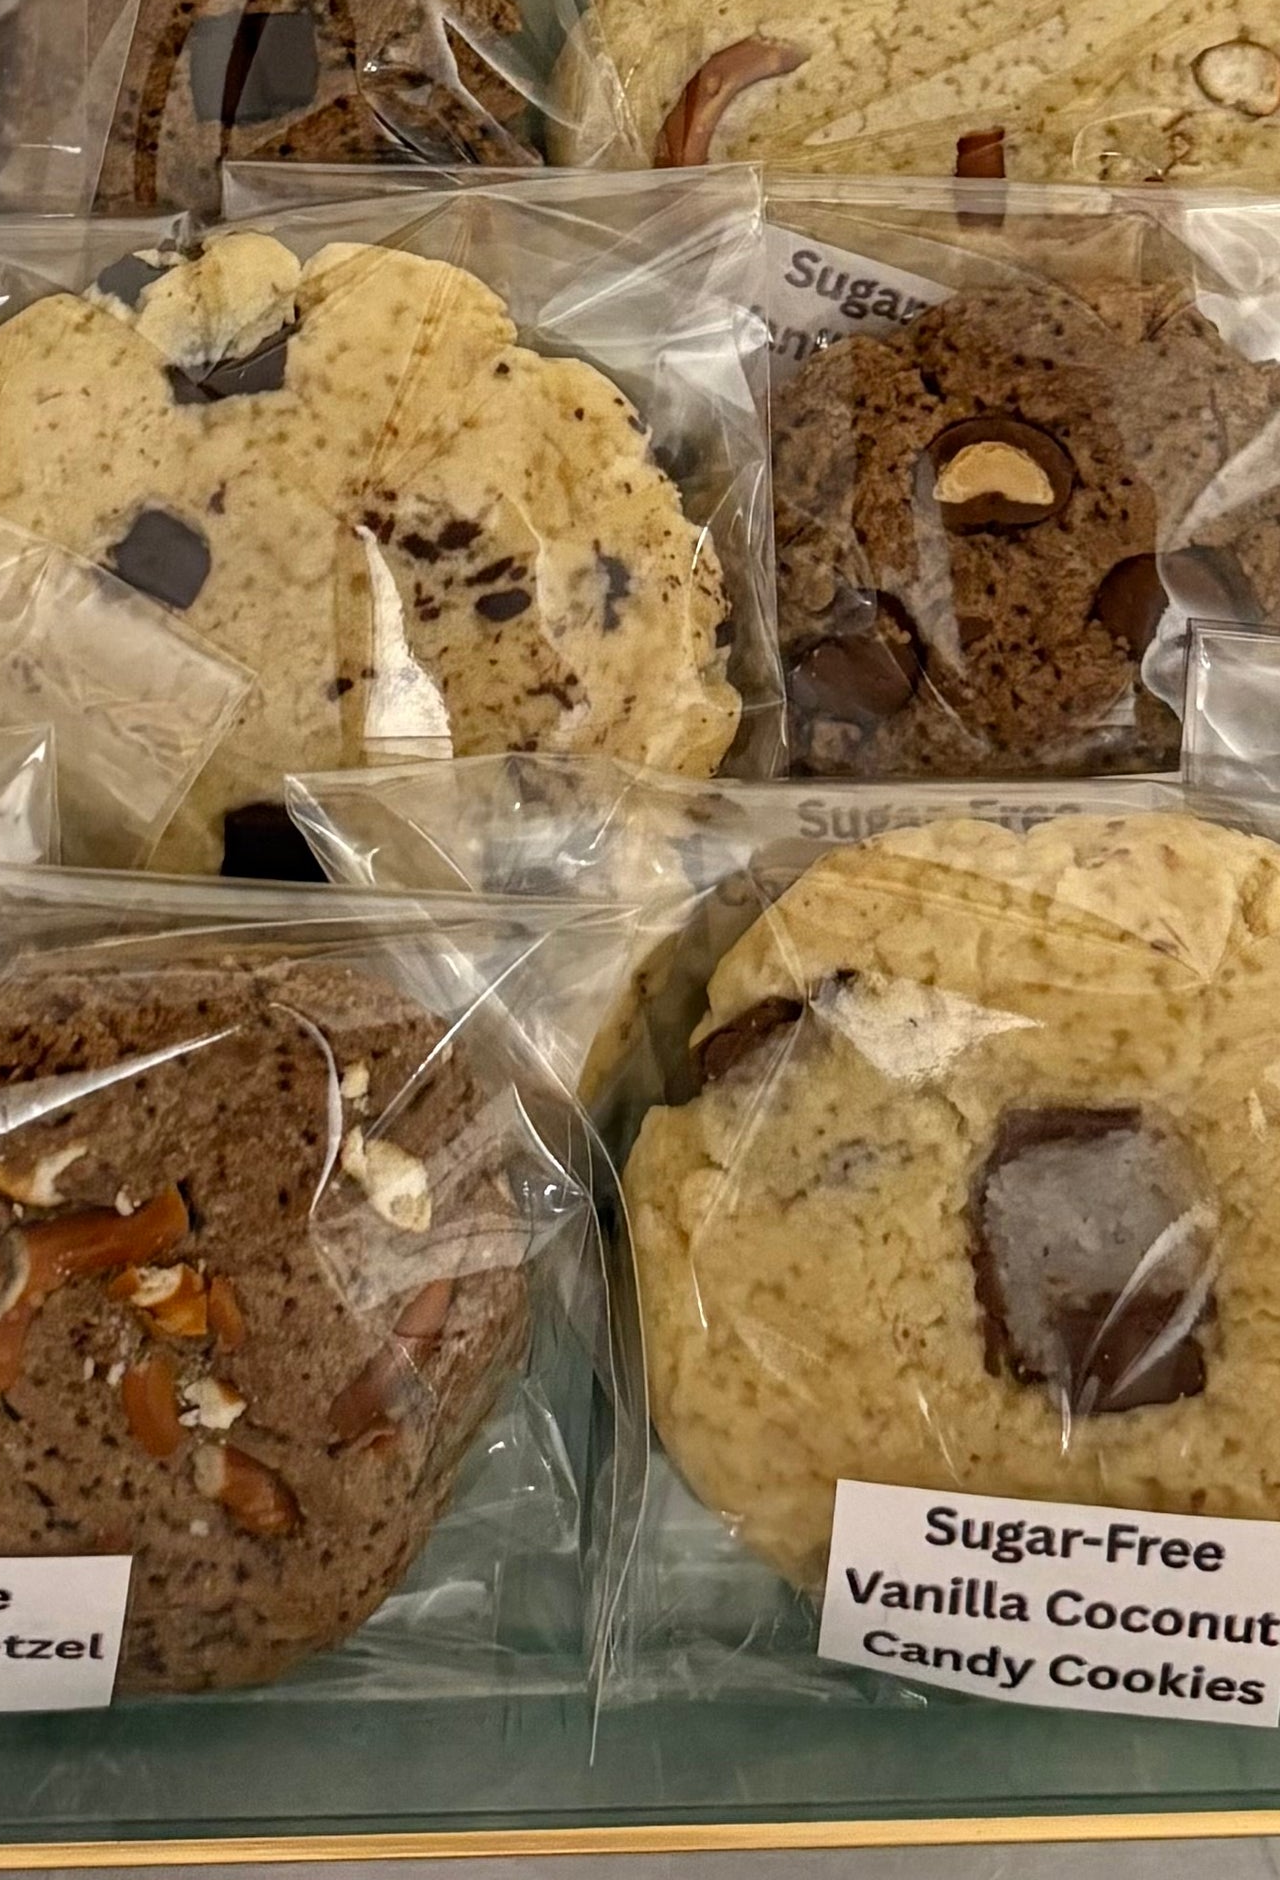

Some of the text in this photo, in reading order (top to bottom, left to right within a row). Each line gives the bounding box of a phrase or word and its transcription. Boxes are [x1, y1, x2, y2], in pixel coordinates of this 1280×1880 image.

[784, 249, 928, 326] Sugar
[924, 1506, 1226, 1572] Sugar-Free
[845, 1567, 1031, 1622] Vanilla
[862, 1630, 1266, 1706] Candy Cookies
